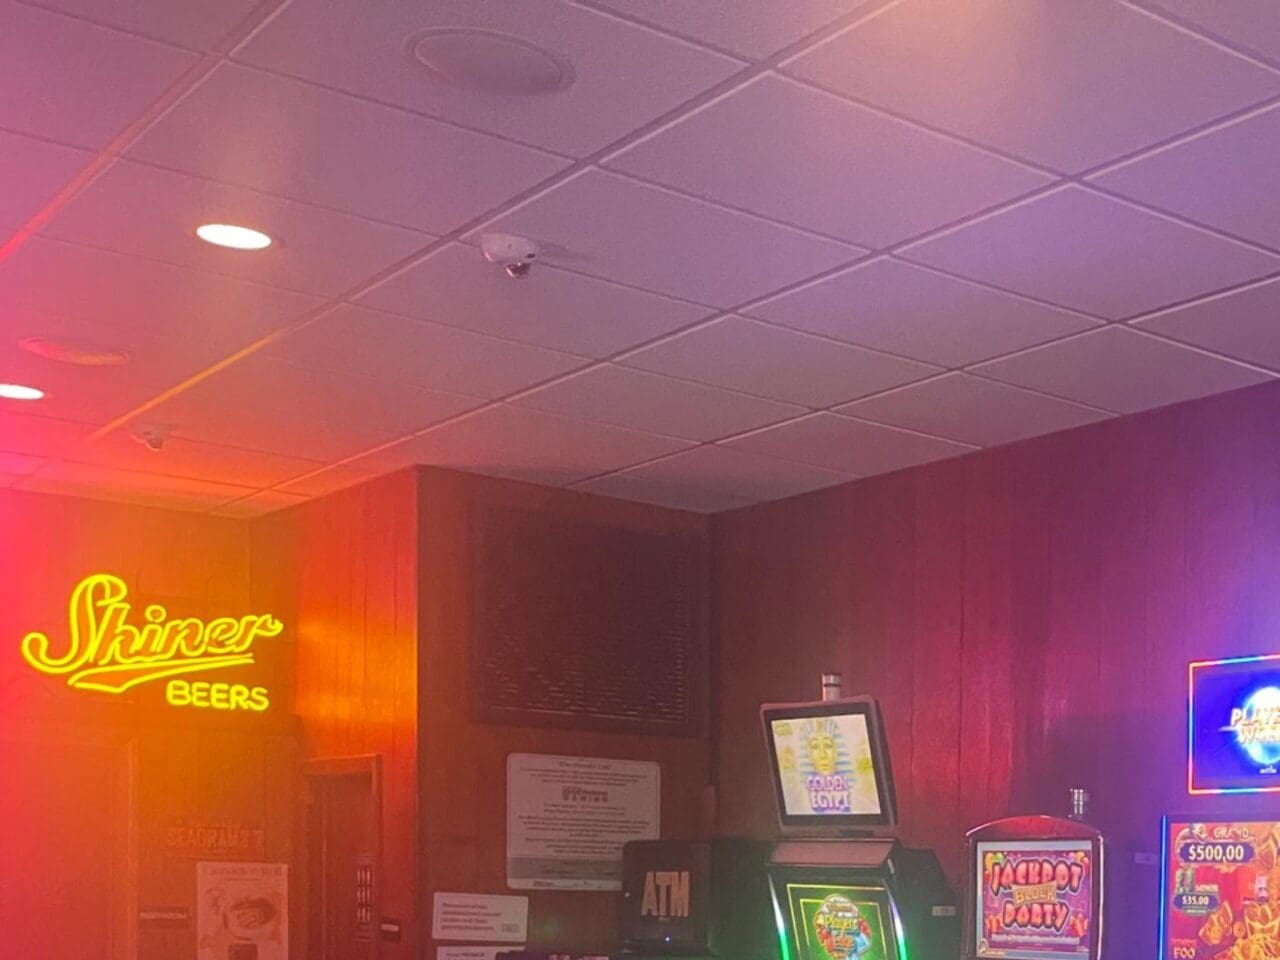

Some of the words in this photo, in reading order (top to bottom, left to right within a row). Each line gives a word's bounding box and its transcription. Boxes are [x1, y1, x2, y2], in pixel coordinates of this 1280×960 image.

[21, 573, 284, 674] Shiner
[166, 679, 270, 711] BEERS
[811, 790, 850, 808] EGYPT
[1188, 844, 1244, 861] $500.00
[990, 858, 1084, 897] JACKPOT
[640, 870, 690, 918] ATM
[1181, 894, 1210, 906] $35.00
[1002, 900, 1070, 933] PARTY
